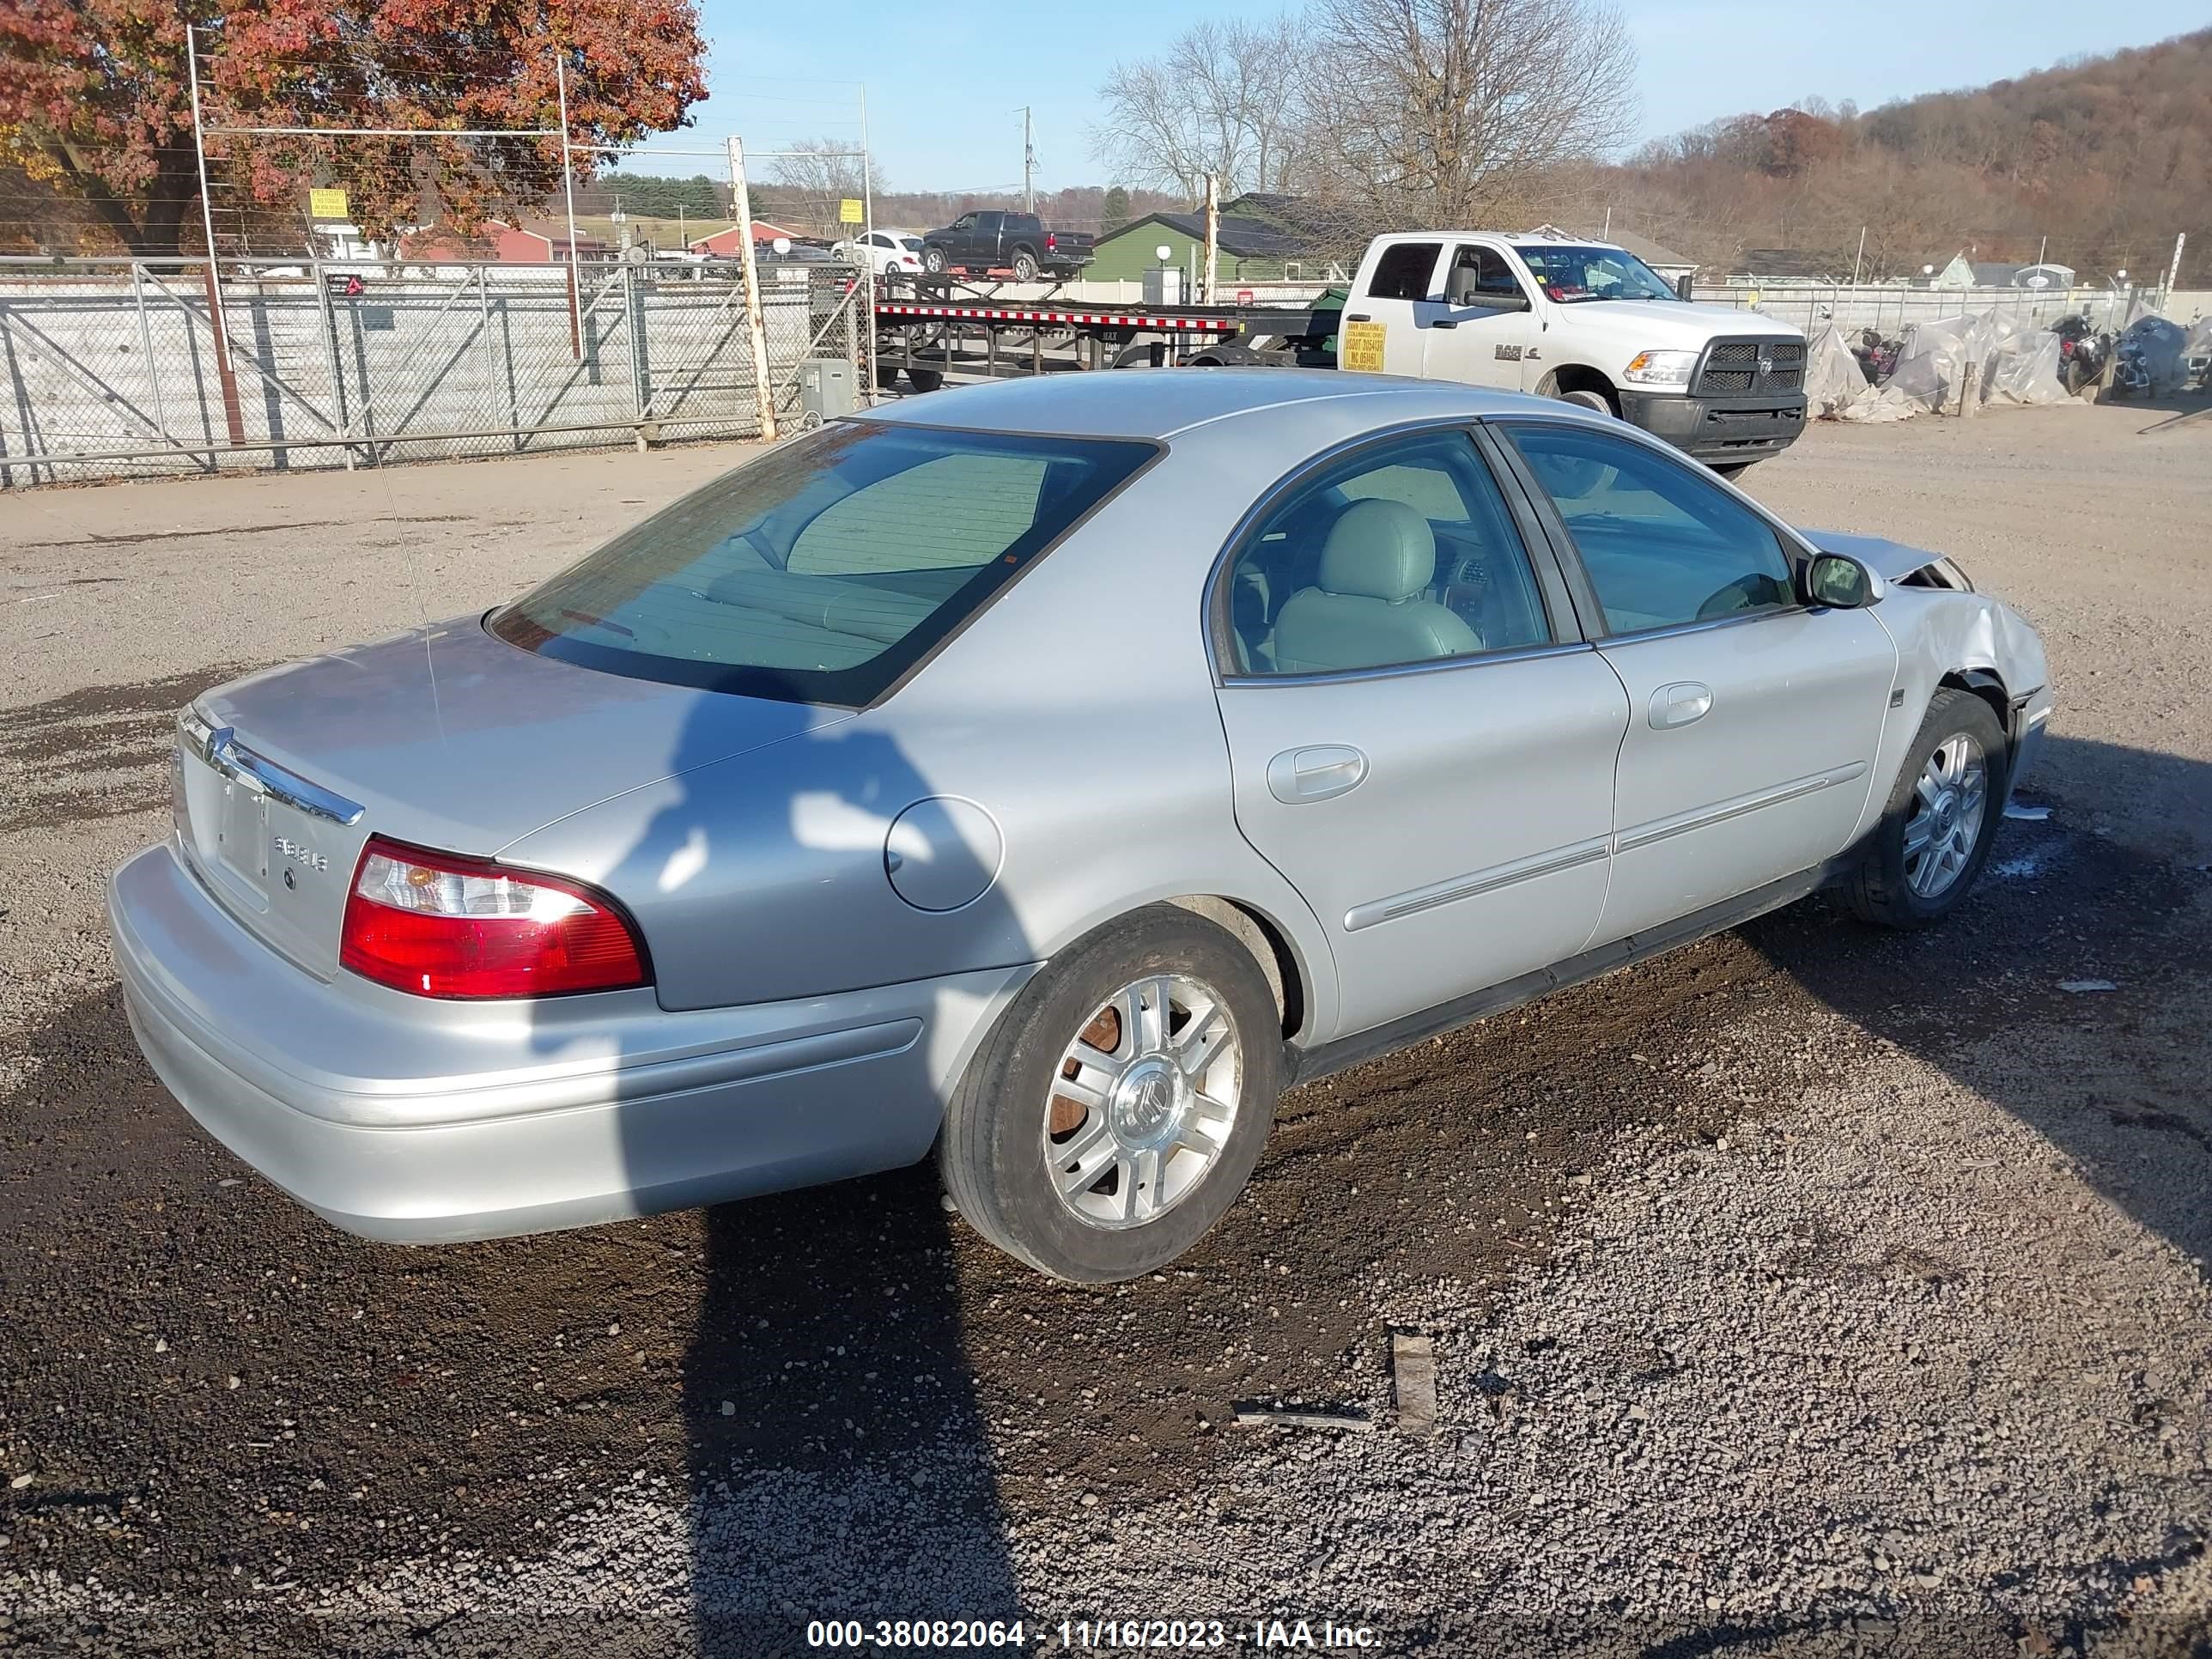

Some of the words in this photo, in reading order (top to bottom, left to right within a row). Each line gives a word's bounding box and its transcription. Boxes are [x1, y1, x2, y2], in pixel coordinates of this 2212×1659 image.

[1359, 323, 1379, 331] TRUCKING
[1104, 343, 1121, 354] Light
[1346, 338, 1361, 350] USDOT
[1351, 351, 1358, 363] MC
